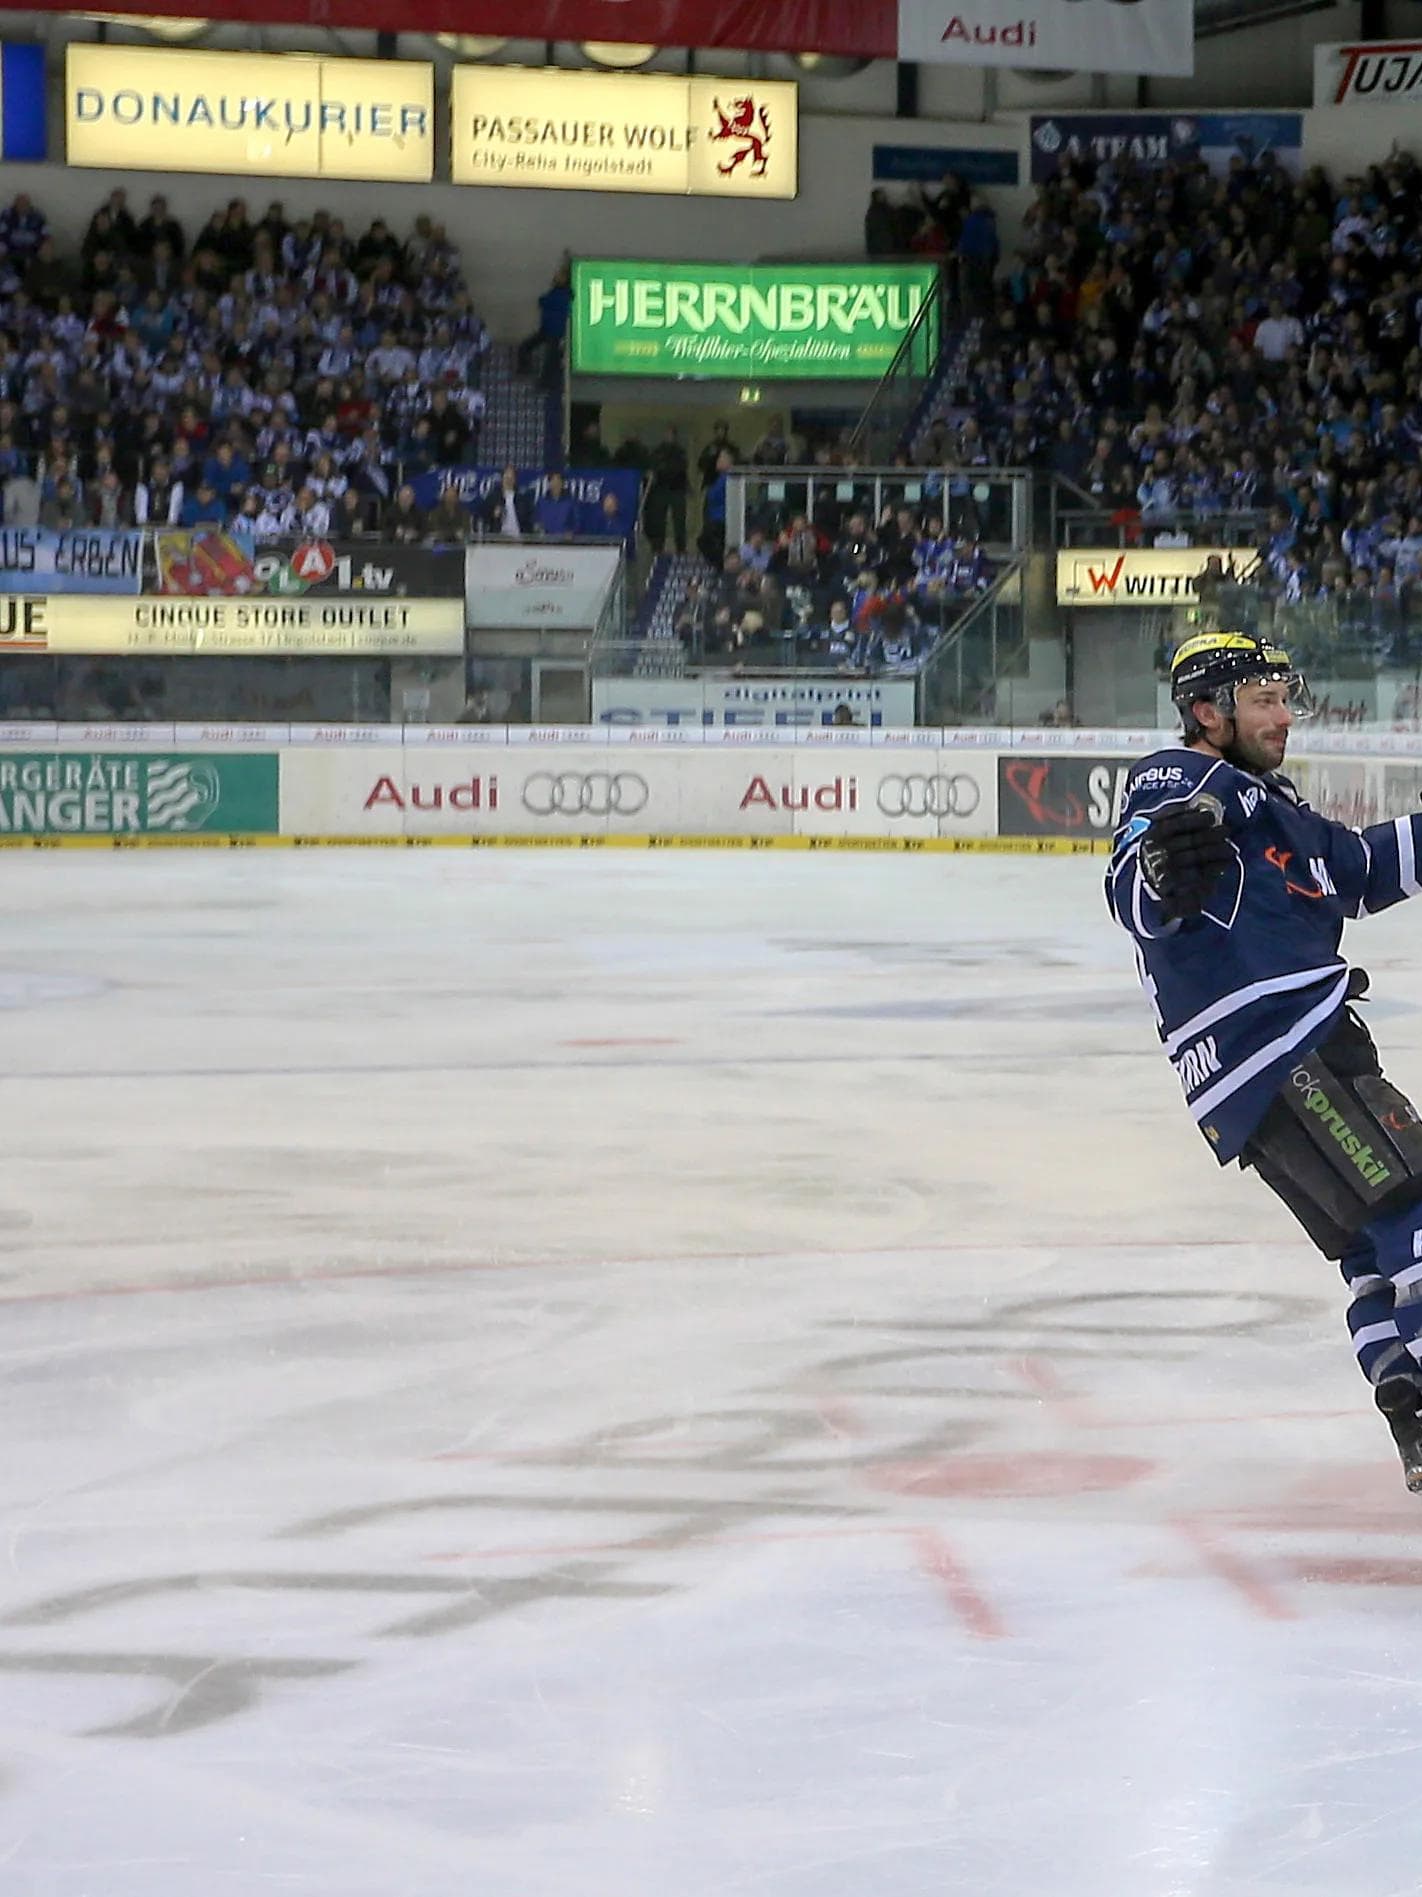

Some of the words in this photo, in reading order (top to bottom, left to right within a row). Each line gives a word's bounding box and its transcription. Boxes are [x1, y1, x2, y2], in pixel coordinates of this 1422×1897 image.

[942, 16, 1037, 47] Audi
[75, 90, 428, 139] DONAUKURIER
[472, 115, 614, 148] PASSAUER
[624, 125, 698, 151] WOLF
[589, 277, 921, 334] HERRNBRÄU
[135, 604, 226, 629] CINQUE
[237, 604, 312, 629] STORE
[322, 604, 411, 629] OUTLET
[363, 774, 499, 811] Audi
[739, 774, 857, 811] Audi
